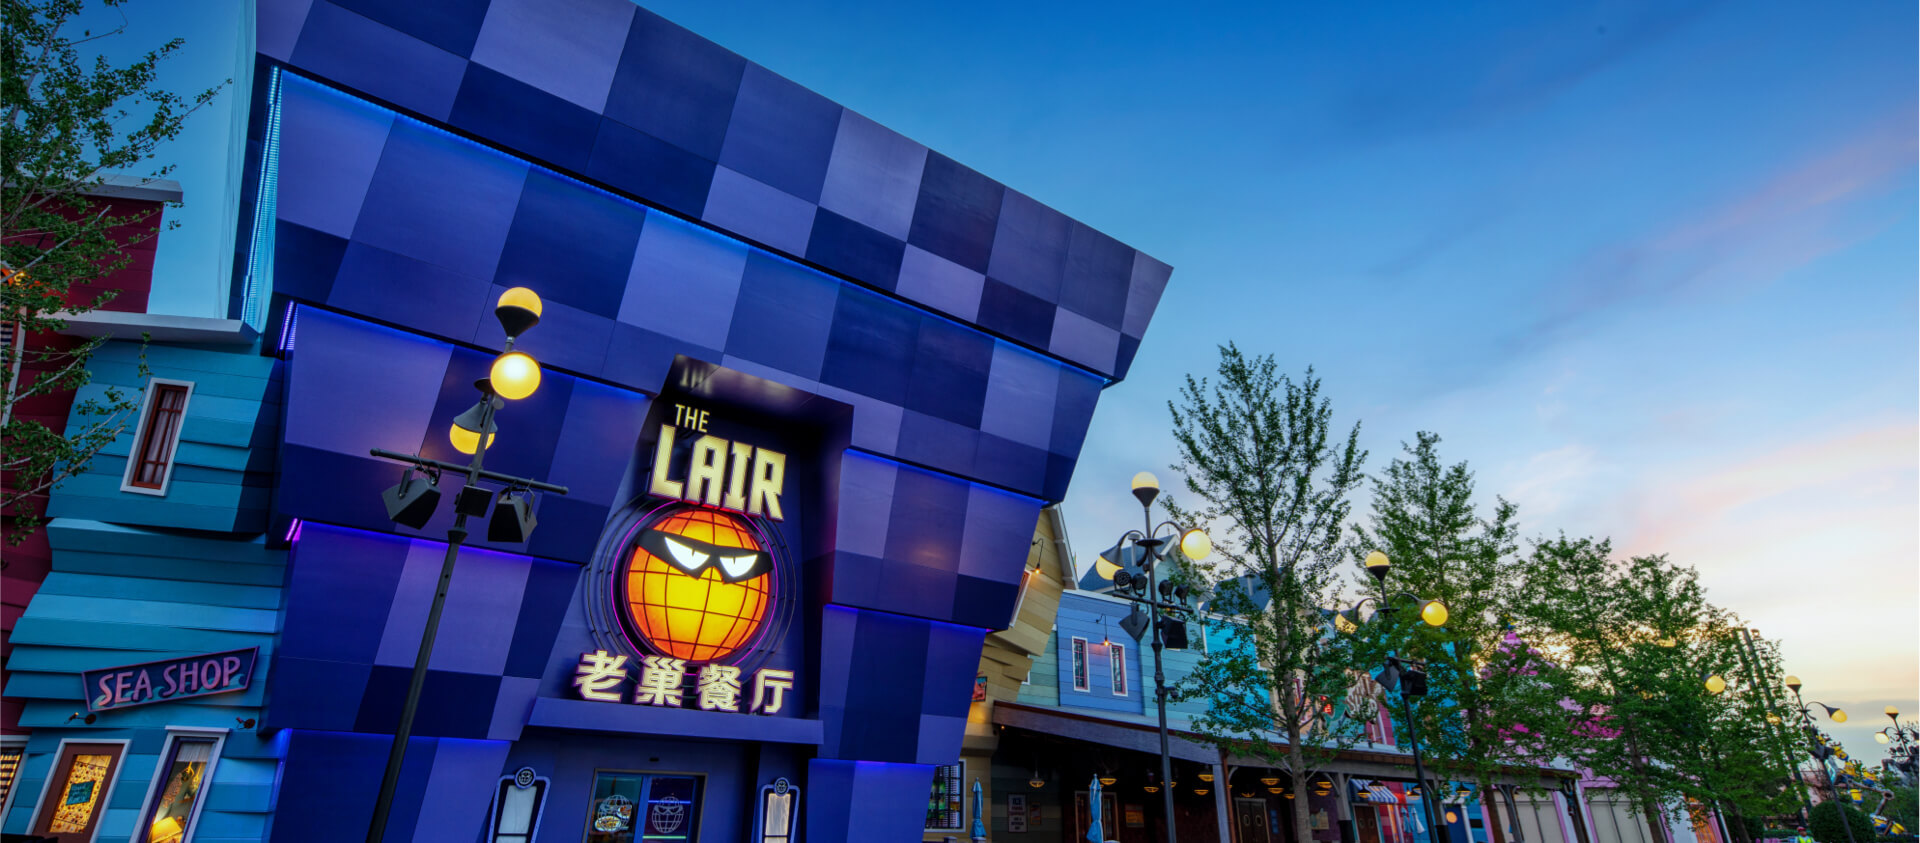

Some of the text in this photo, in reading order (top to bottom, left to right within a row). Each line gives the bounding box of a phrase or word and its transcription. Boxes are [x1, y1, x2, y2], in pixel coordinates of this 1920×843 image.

[675, 403, 710, 433] THE
[649, 425, 787, 521] LAIR
[98, 656, 240, 706] SEA SHOP
[573, 649, 795, 714] 老巢餐厅
[1345, 694, 1378, 717] SHP
